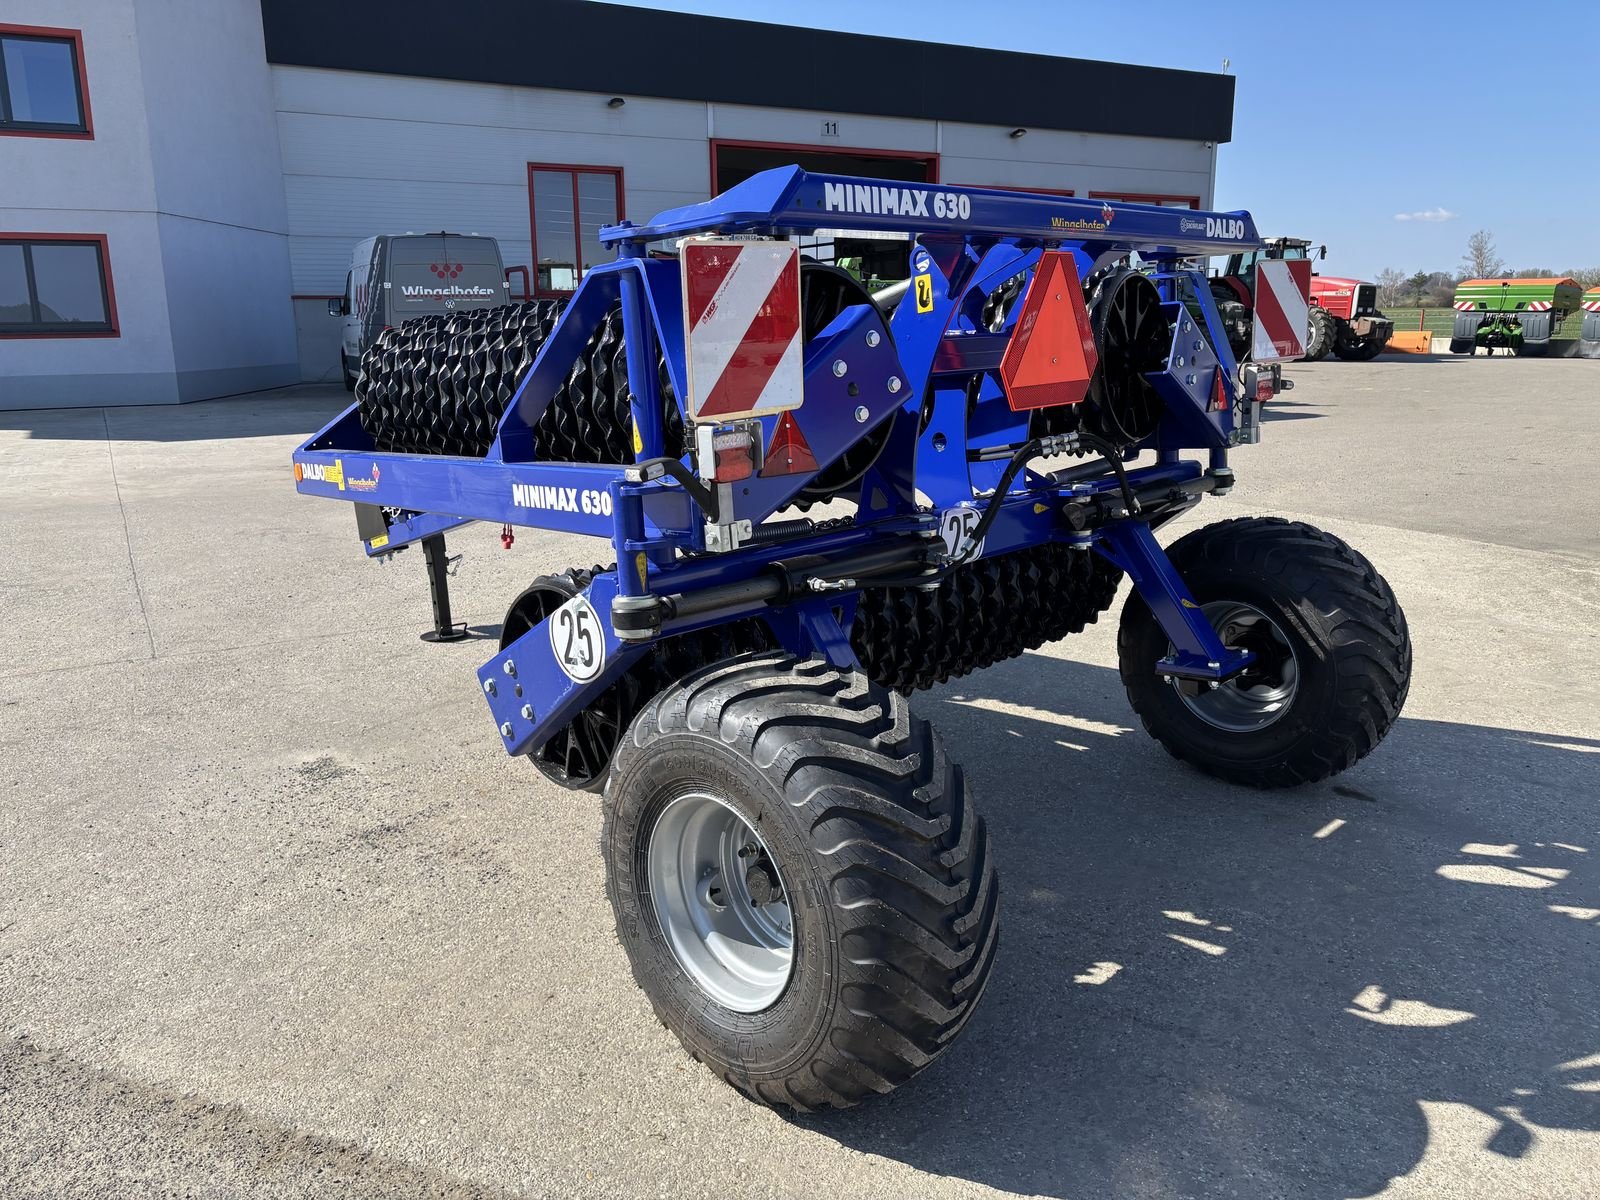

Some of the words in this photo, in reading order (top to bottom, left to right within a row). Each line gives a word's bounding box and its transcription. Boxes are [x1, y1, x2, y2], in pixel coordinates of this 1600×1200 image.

[824, 122, 837, 135] 11
[824, 182, 929, 217] MINIMAX
[933, 192, 971, 220] 630
[1051, 216, 1106, 232] Wingelhofer
[1206, 217, 1245, 239] DALBO
[401, 286, 494, 302] Wingelhofer
[301, 463, 325, 481] DALBO
[512, 484, 579, 512] MINIMAX
[581, 490, 612, 516] 630
[560, 609, 593, 667] 25
